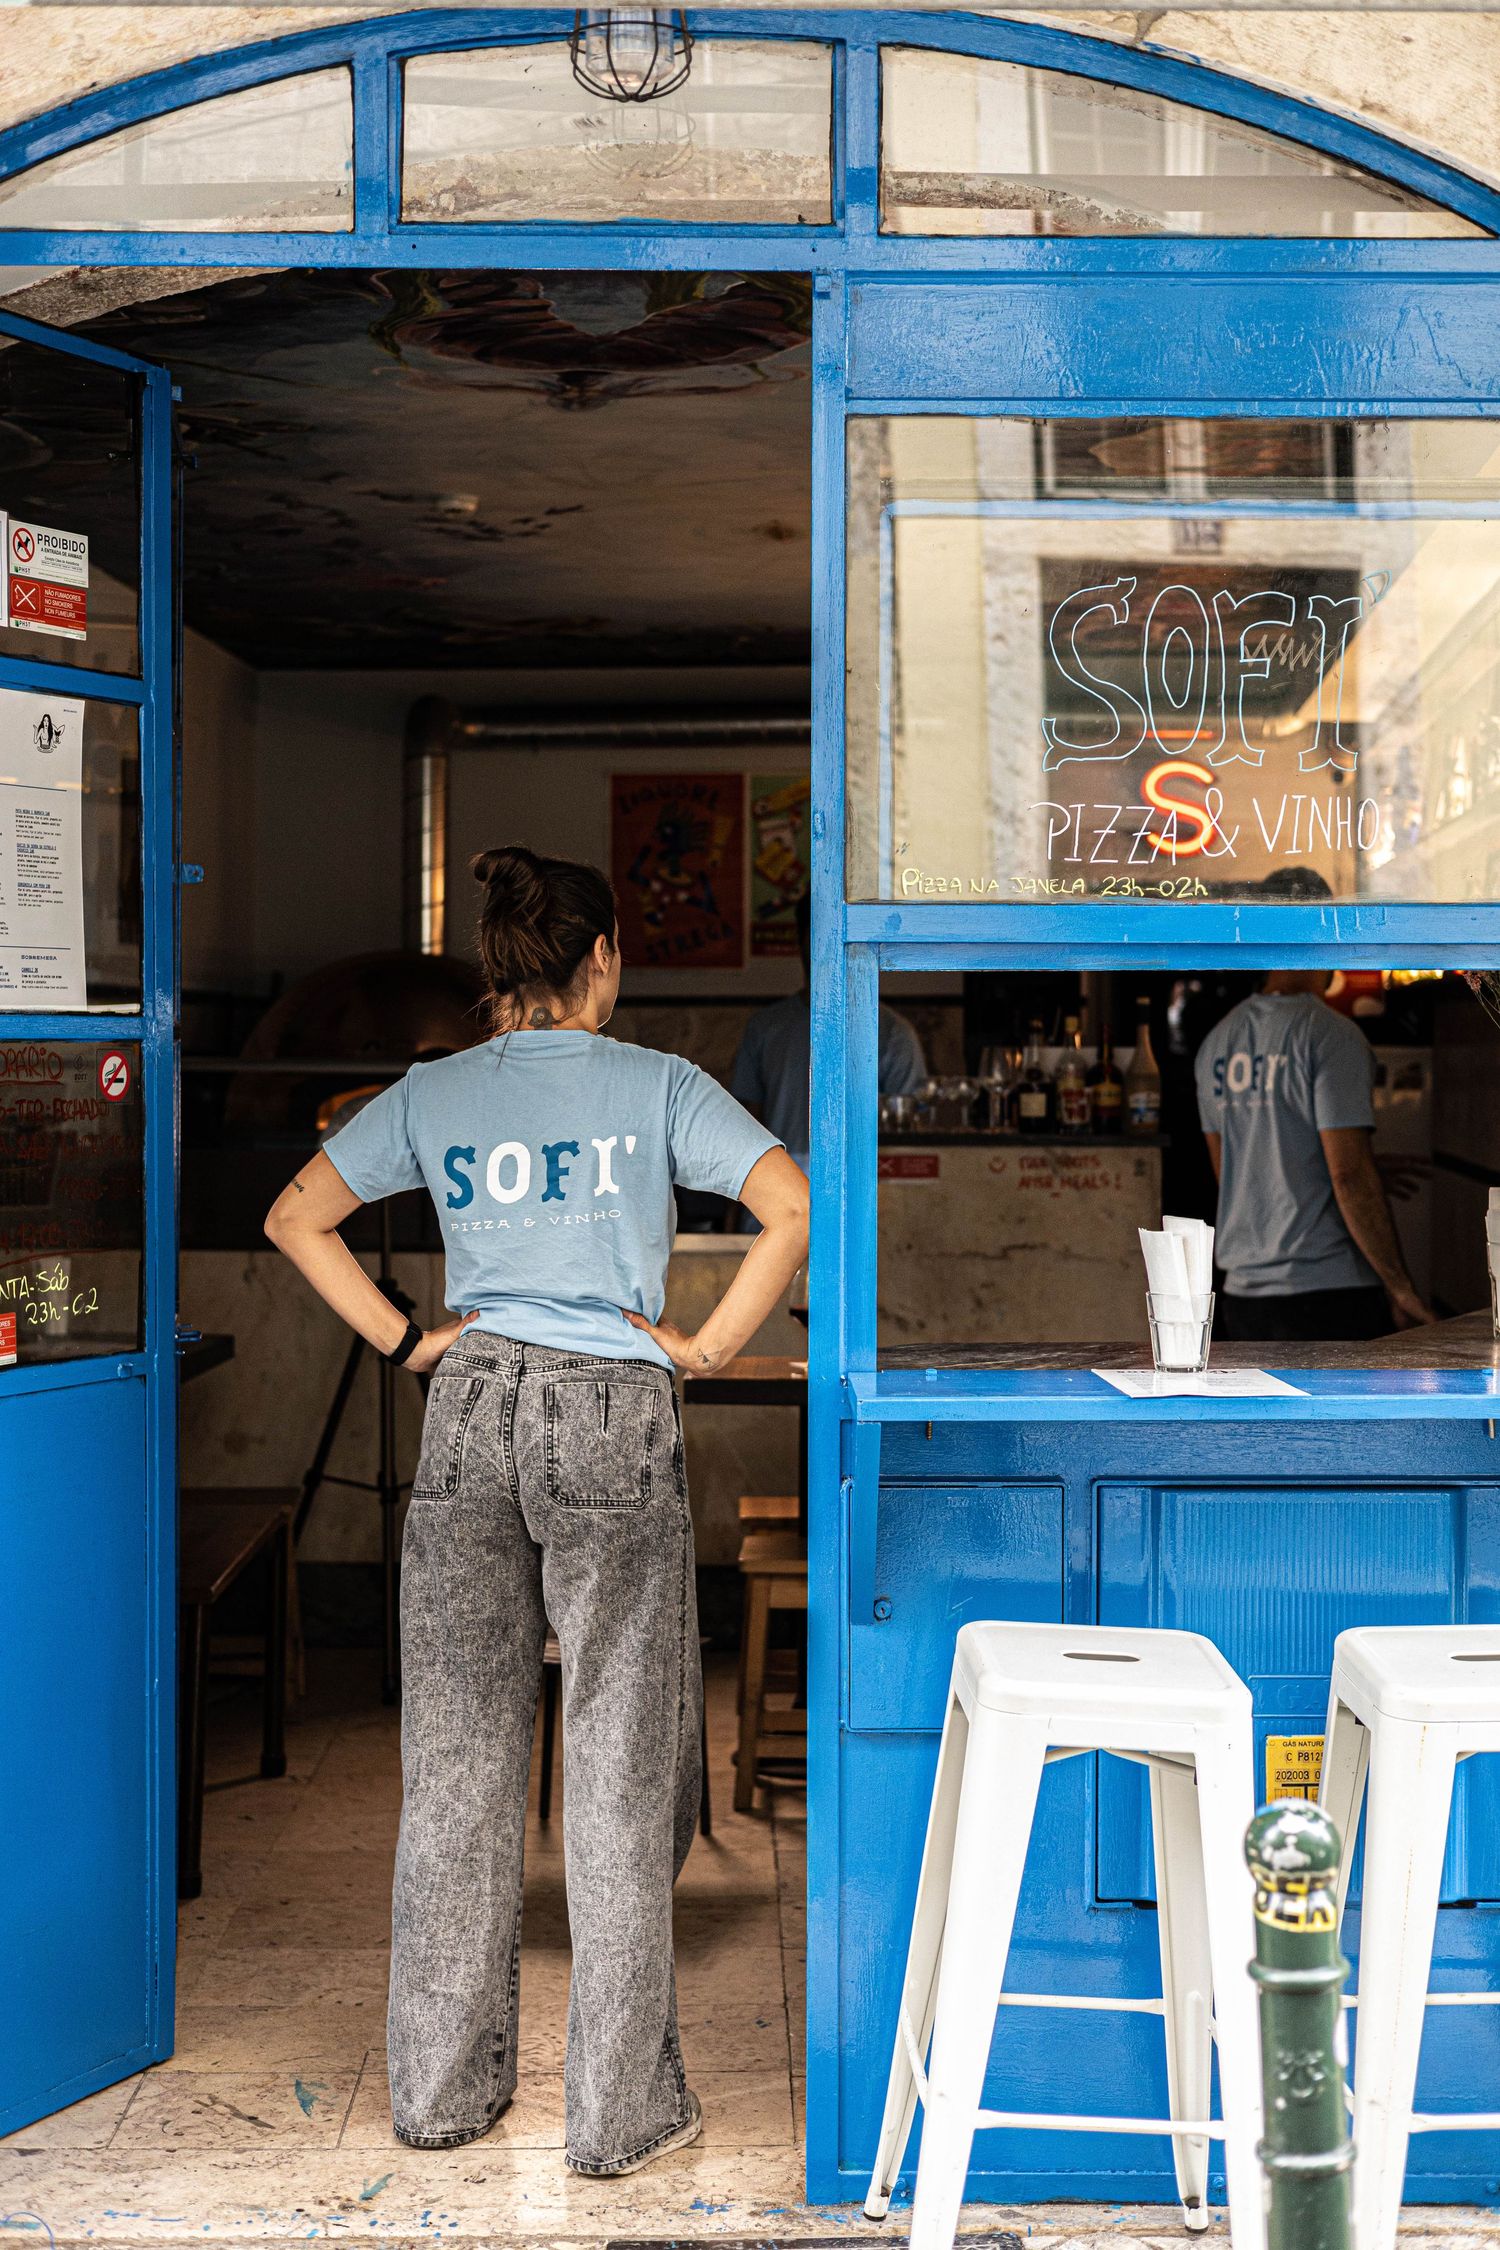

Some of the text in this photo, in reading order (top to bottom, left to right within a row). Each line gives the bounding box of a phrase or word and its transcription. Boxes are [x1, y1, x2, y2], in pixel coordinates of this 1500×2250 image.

[37, 533, 86, 554] PROIBIDO
[45, 548, 61, 556] ENTRADA
[54, 590, 81, 602] FUMADORES
[52, 601, 73, 609] SMOKERS
[55, 610, 76, 618] FUMEURS
[1027, 787, 1381, 865] PIZZA & VINHO
[970, 878, 1000, 894] NA
[1008, 876, 1086, 895] JANELA
[451, 1209, 621, 1232] PIZZA & VINHO
[1298, 1740, 1325, 1748] NATURA
[1286, 1752, 1293, 1762] C
[1276, 1770, 1310, 1781] 202003
